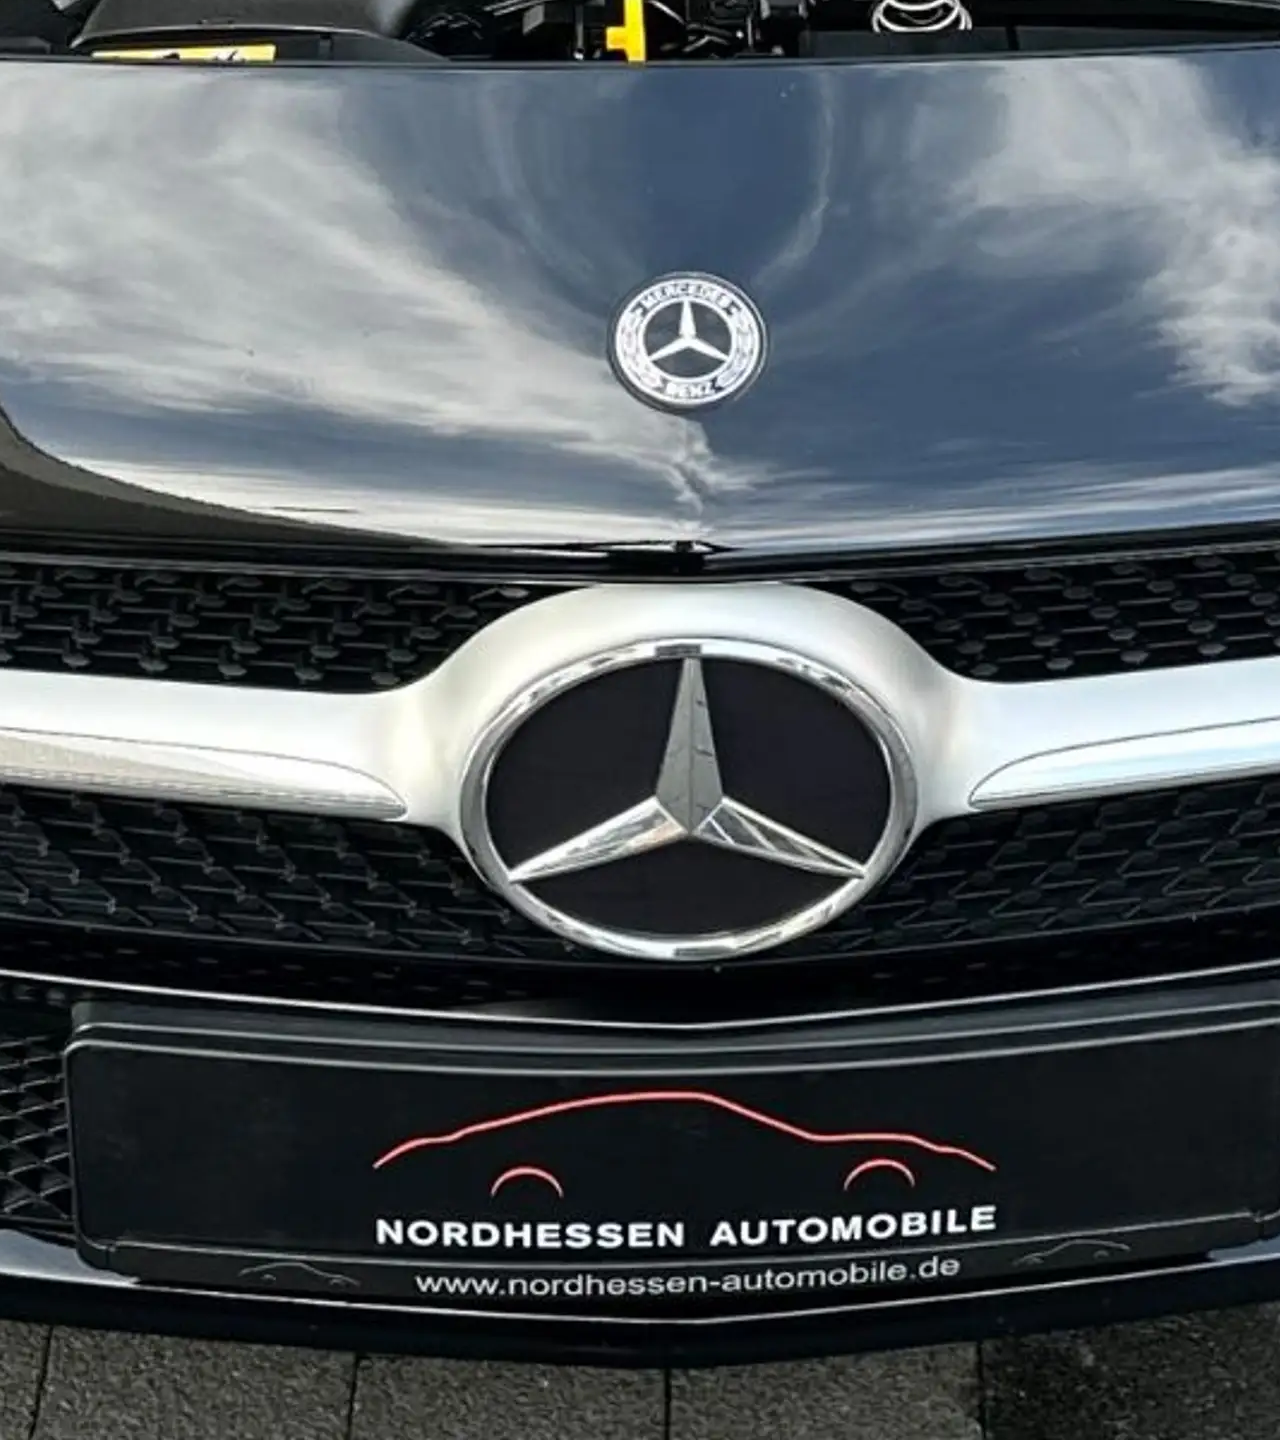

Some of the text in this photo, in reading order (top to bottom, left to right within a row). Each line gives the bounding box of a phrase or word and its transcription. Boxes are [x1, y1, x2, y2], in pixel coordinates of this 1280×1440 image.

[375, 1204, 998, 1249] NORDHESSEN AUTOMOBILE
[414, 1255, 961, 1295] www.nordhessen-automobile.de
